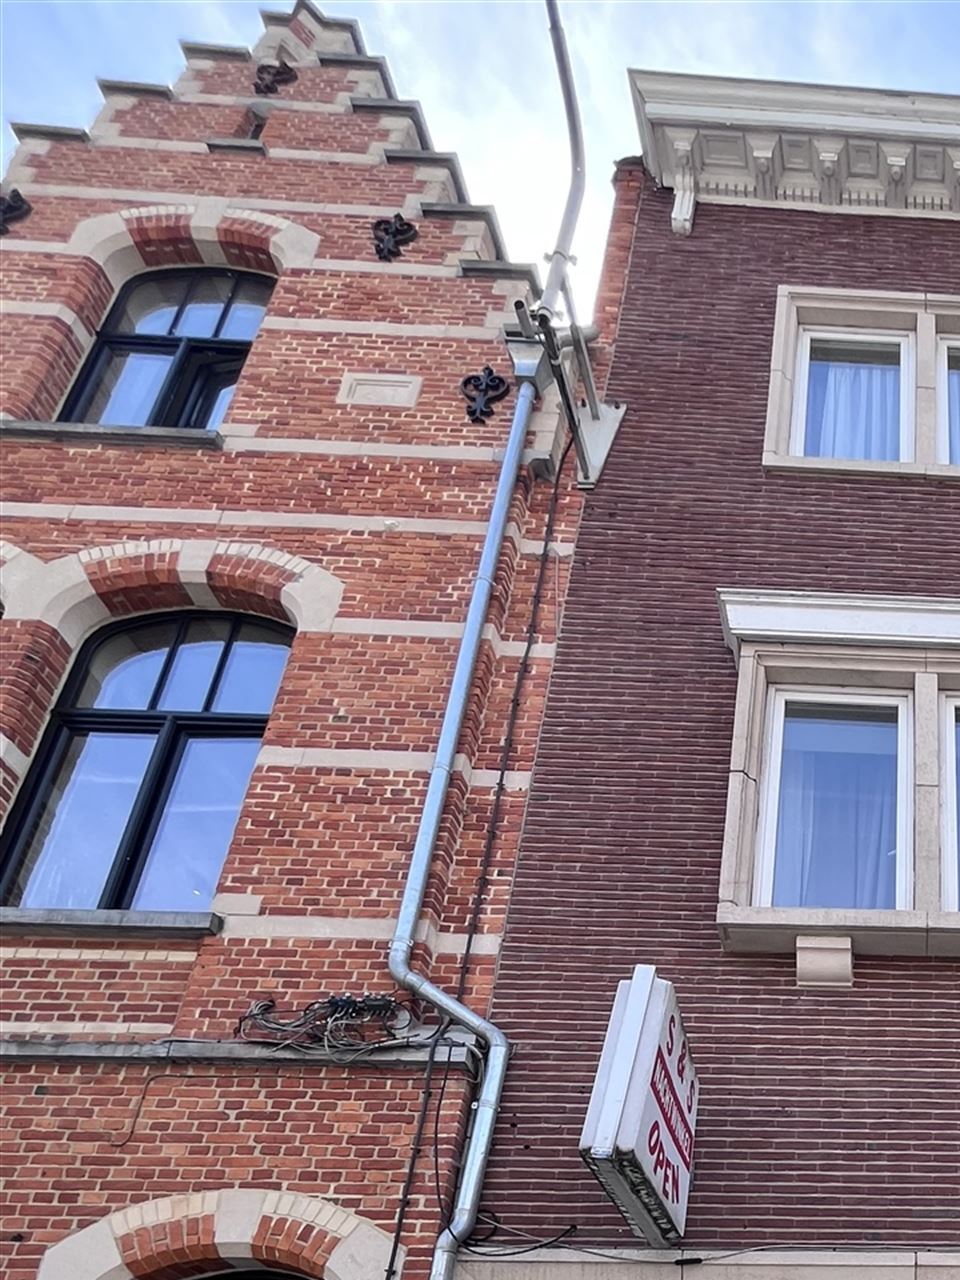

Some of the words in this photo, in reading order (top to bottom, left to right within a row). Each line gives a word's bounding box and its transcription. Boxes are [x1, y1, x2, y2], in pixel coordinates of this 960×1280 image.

[667, 1015, 676, 1057] S
[686, 1079, 696, 1114] S
[648, 1120, 680, 1205] OPEN
